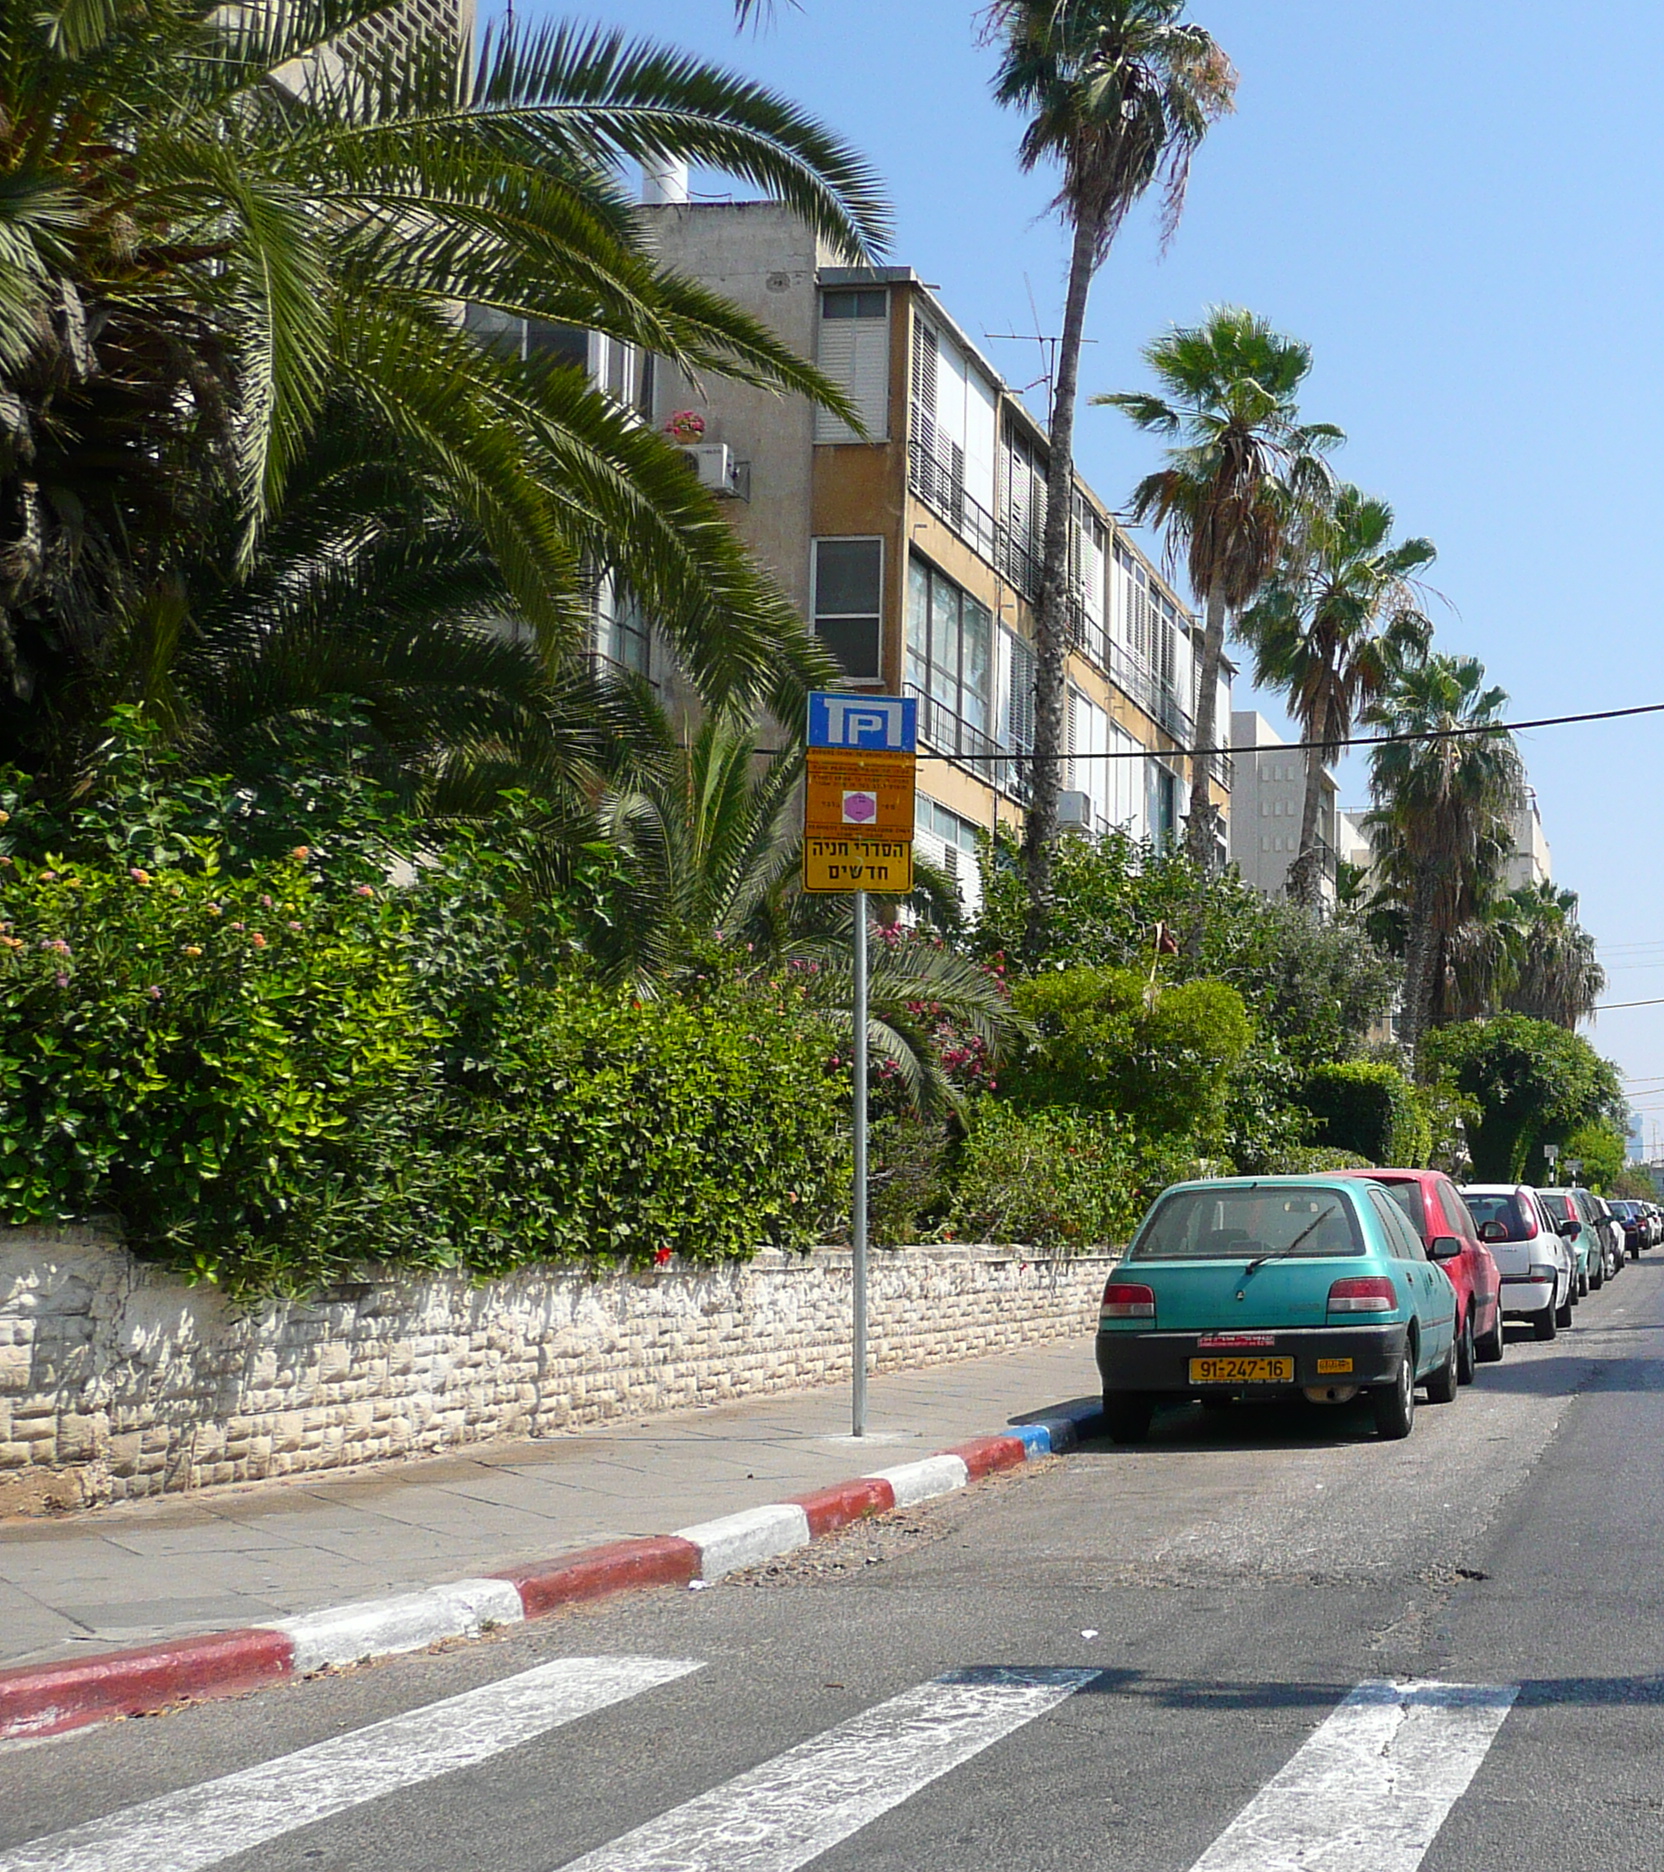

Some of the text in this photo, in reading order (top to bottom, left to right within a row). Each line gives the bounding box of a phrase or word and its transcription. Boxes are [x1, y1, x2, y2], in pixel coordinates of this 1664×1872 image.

[812, 841, 903, 857] הסדרי חניה
[828, 865, 888, 880] חדשים
[1201, 1360, 1284, 1378] 91-247-16
